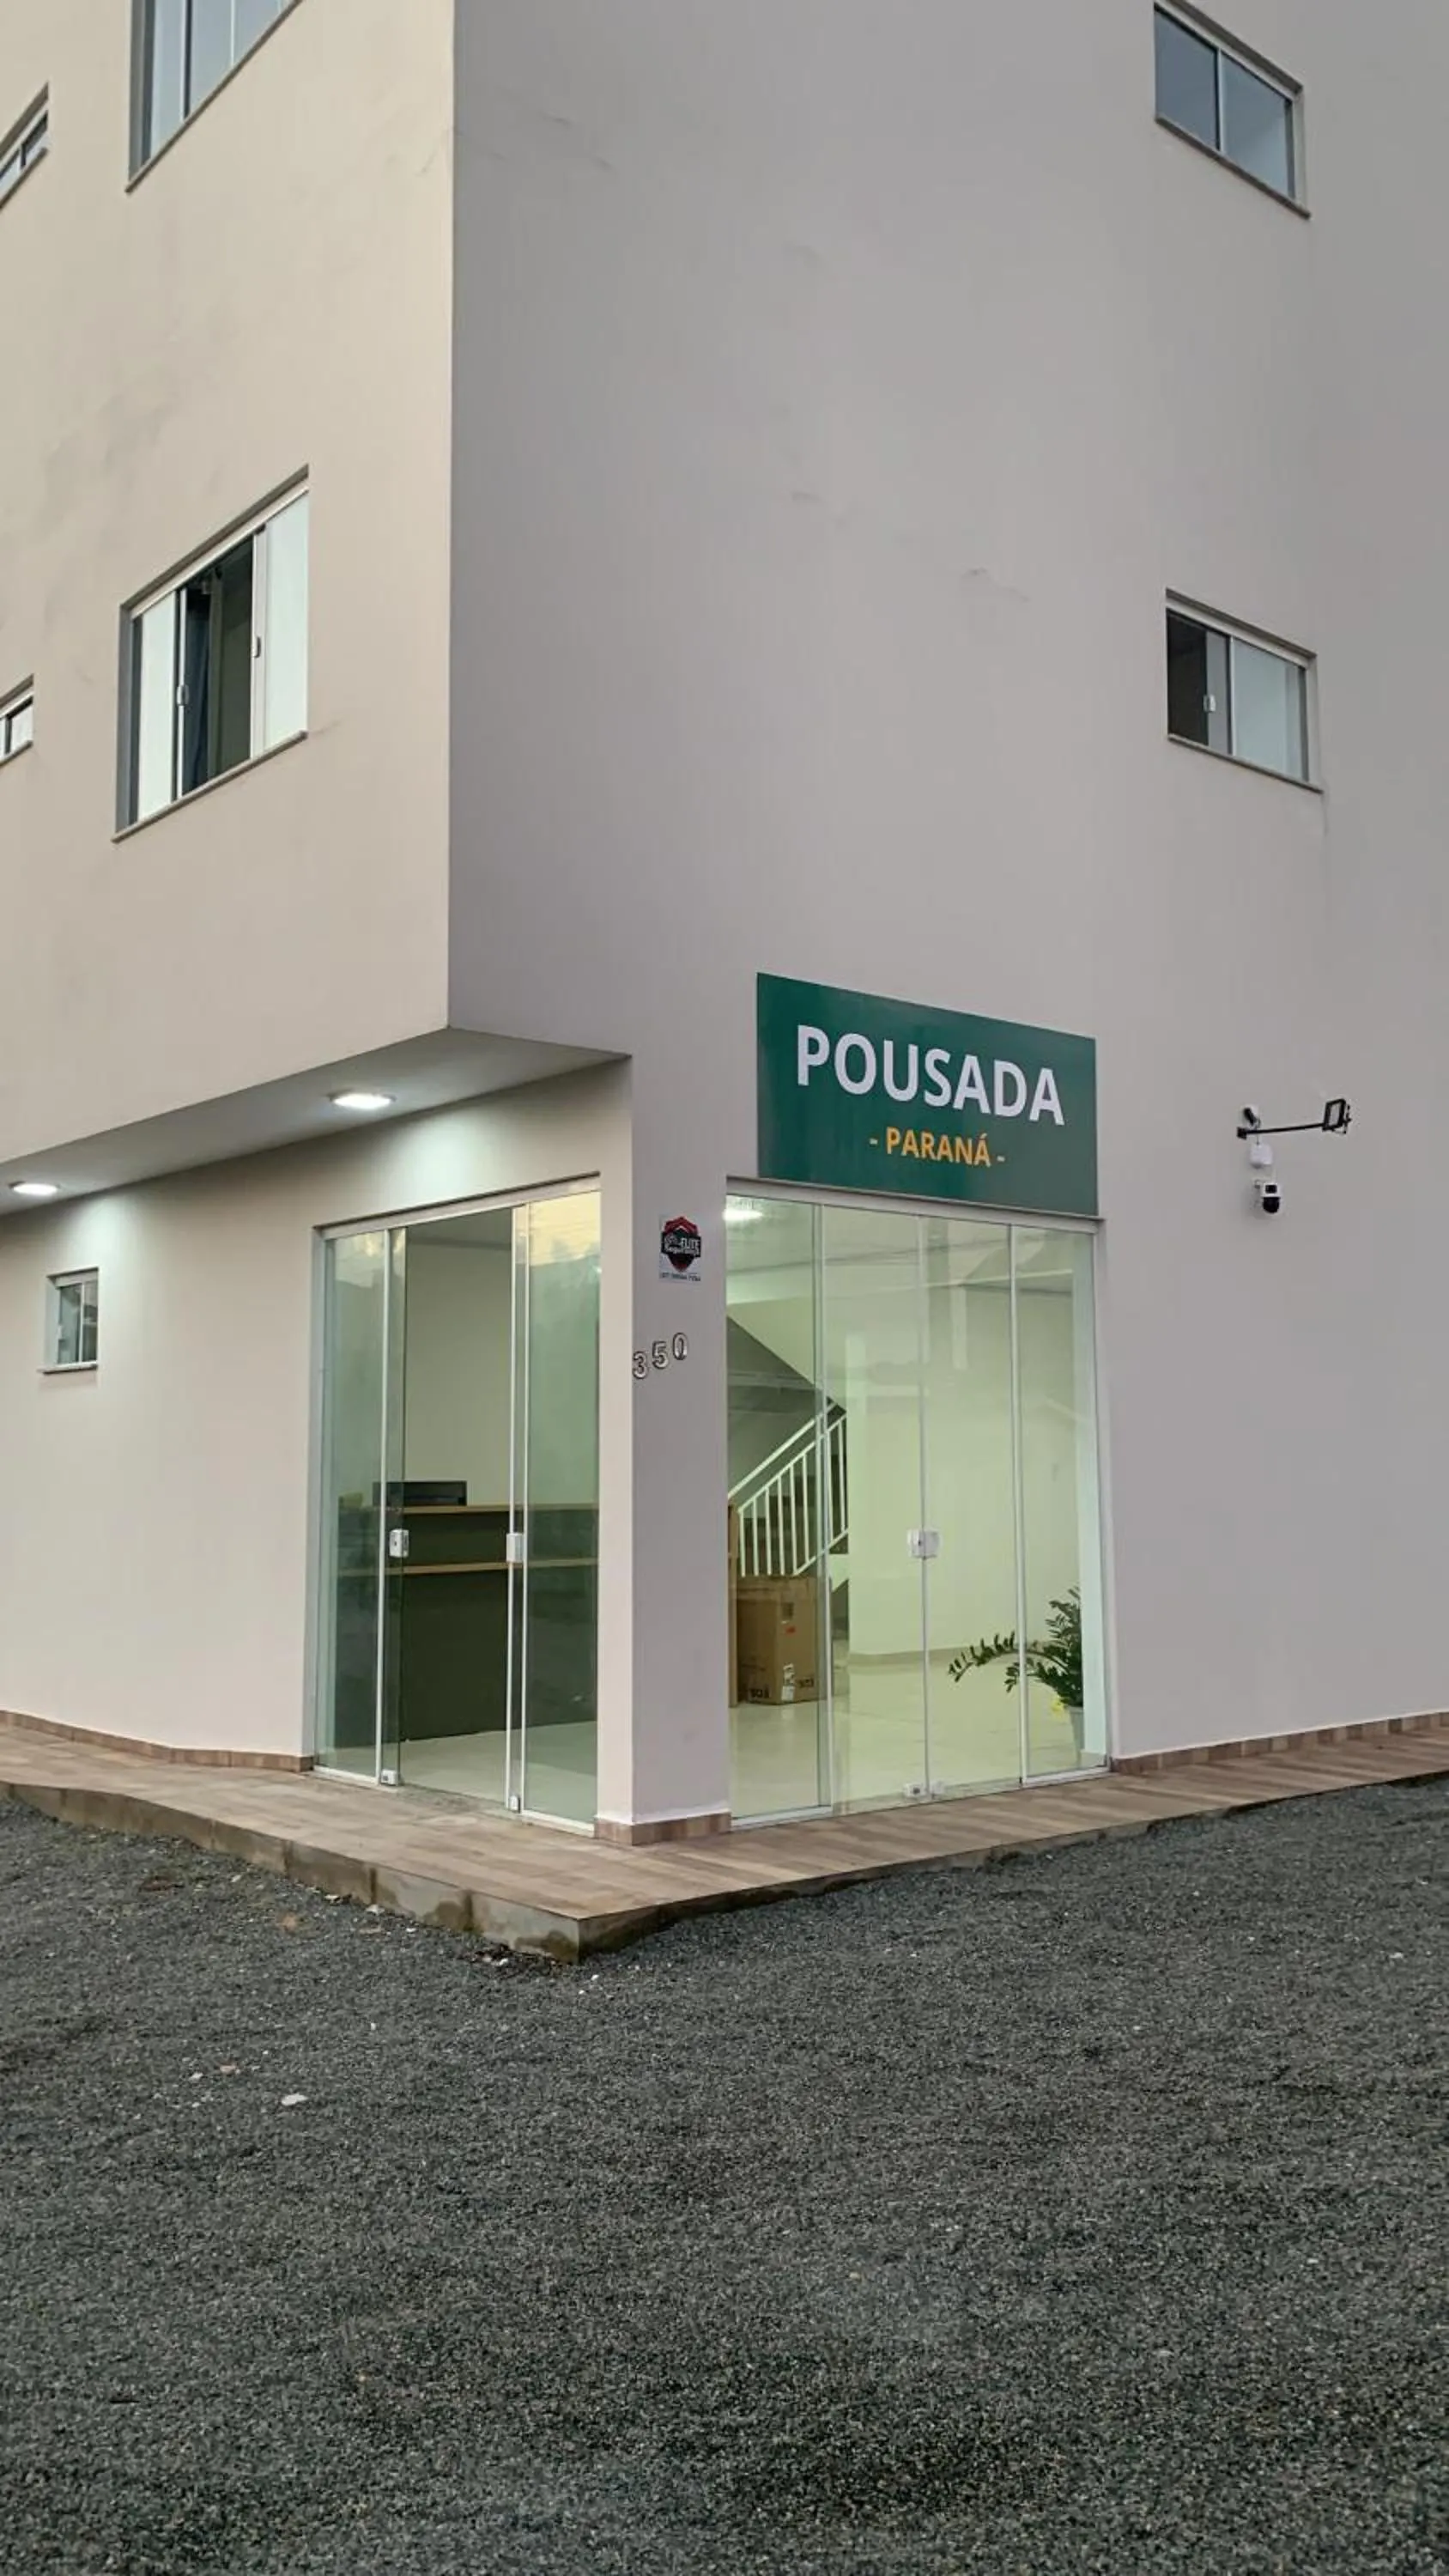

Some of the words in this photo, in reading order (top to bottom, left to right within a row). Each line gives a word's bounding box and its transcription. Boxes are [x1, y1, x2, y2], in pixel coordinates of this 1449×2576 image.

[797, 1024, 1064, 1126] POUSADA
[886, 1127, 991, 1167] PARANÁ
[633, 1333, 688, 1379] 350
